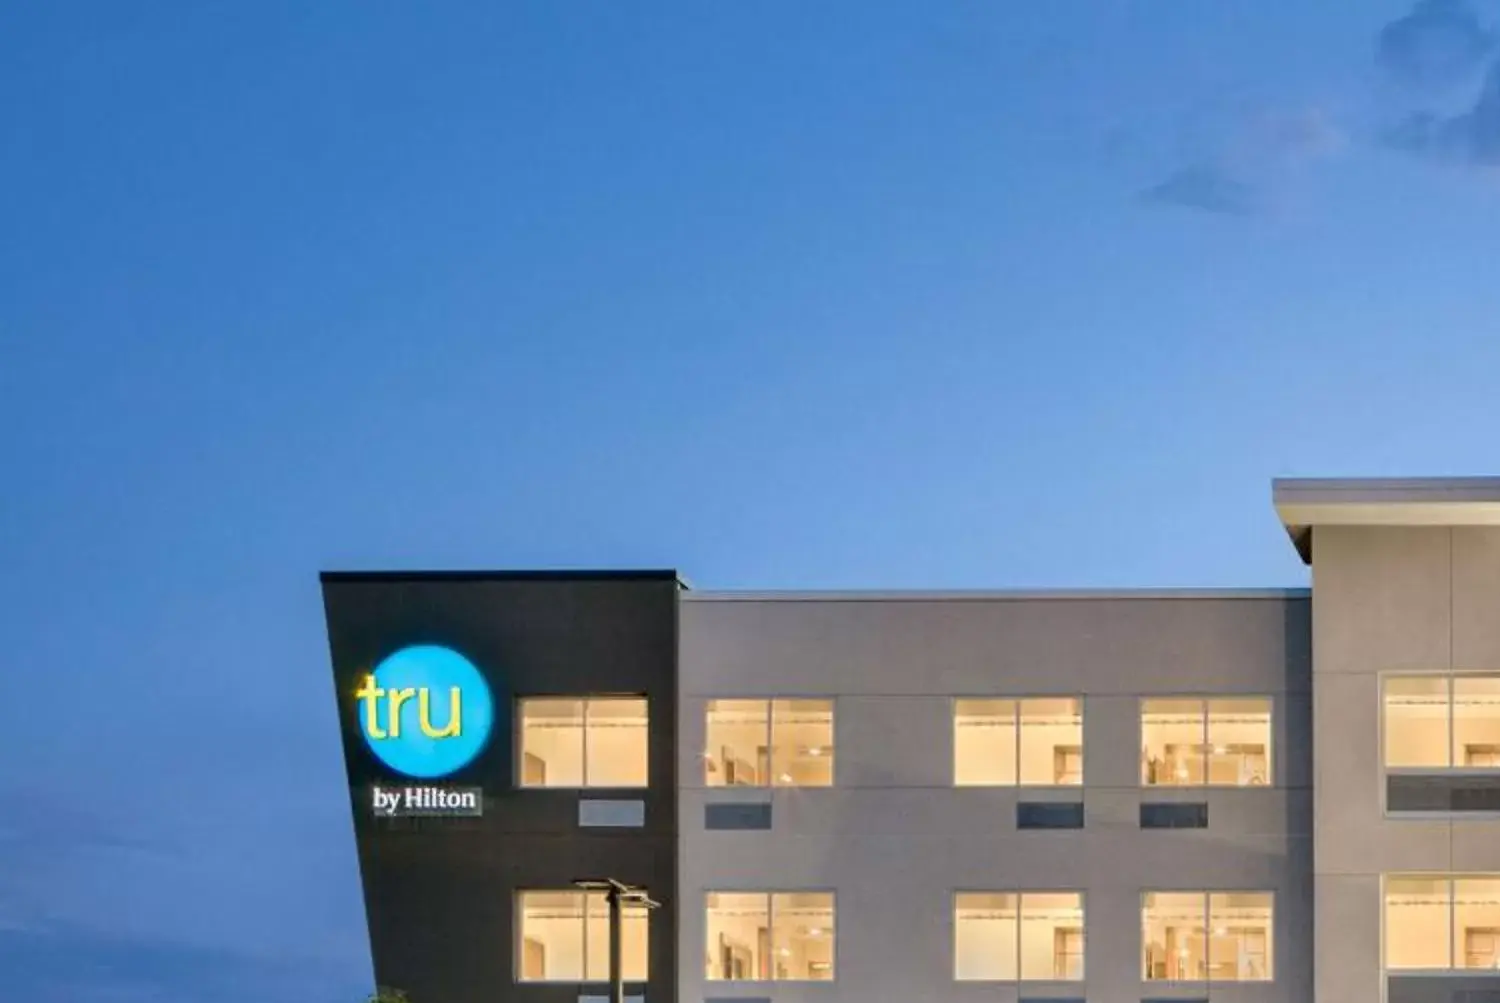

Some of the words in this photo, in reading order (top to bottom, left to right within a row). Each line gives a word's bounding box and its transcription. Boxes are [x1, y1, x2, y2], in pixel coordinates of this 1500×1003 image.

[356, 674, 461, 738] tru
[373, 788, 400, 814] by
[405, 788, 476, 808] Hilton
